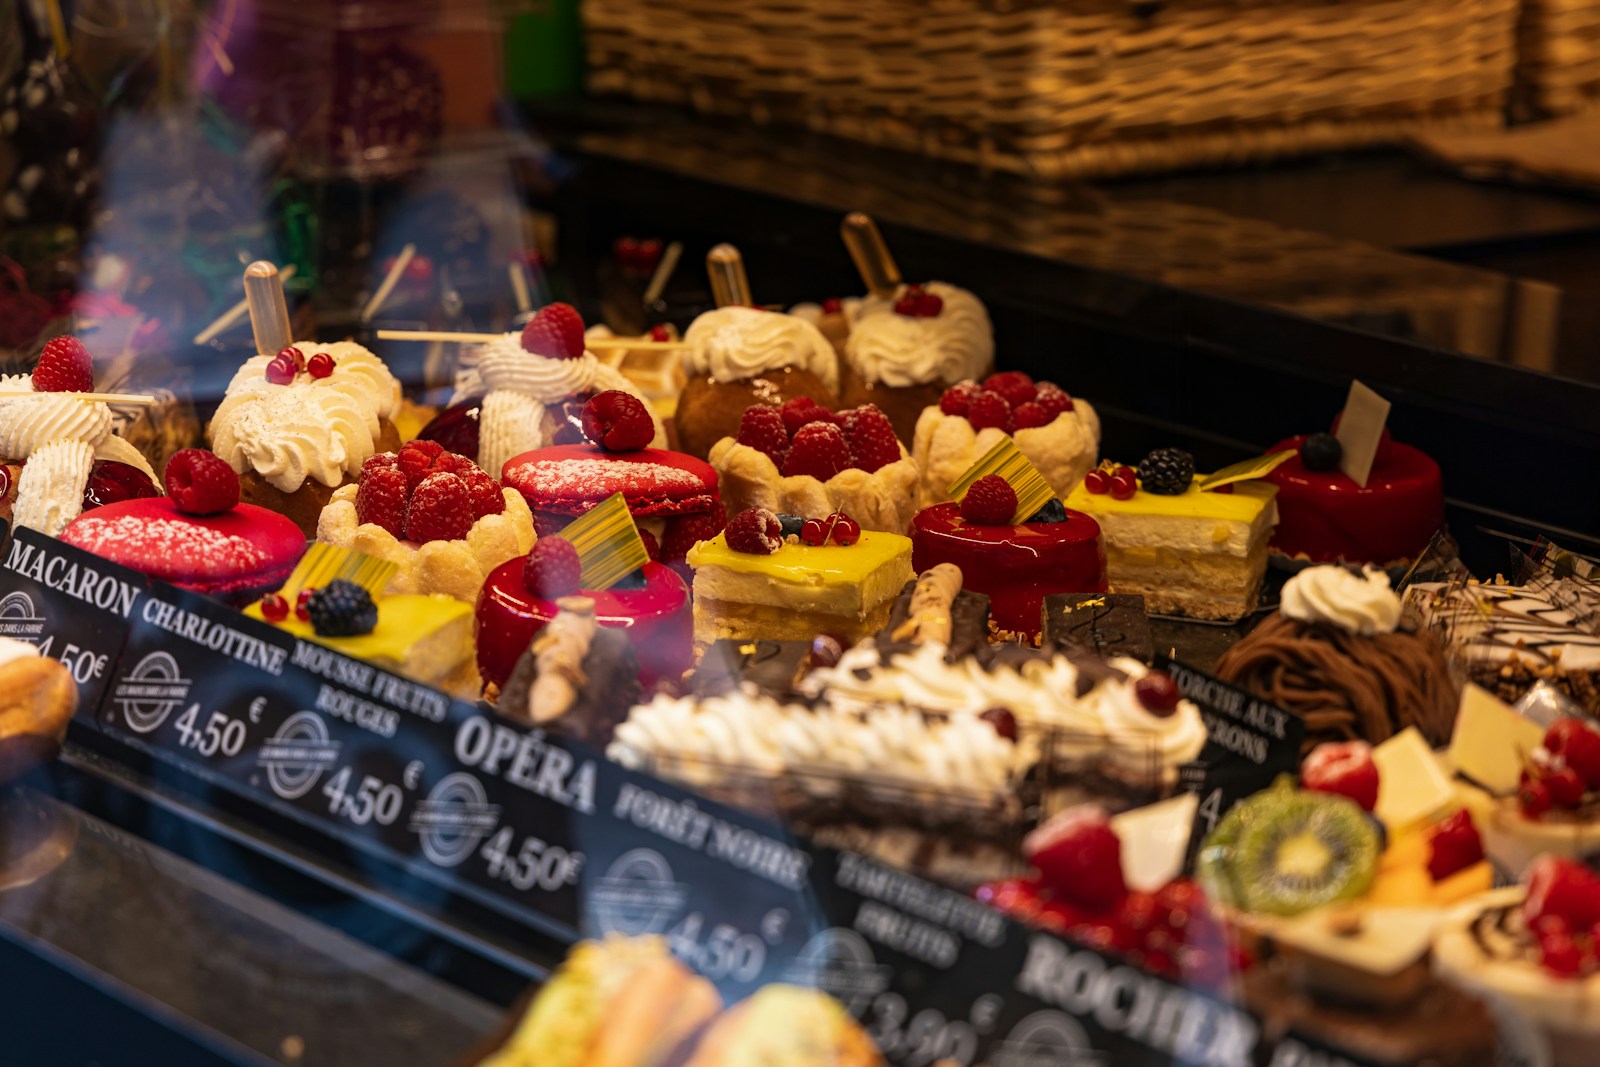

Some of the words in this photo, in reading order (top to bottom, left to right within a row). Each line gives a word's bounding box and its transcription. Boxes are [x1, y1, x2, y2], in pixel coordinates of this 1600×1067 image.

[4, 539, 140, 618] MACARON
[142, 598, 288, 676] CHARLOTTINE
[291, 640, 376, 693] MOUSSE
[372, 672, 449, 723] FRUITS
[315, 684, 400, 738] ROUGES
[1168, 663, 1245, 719] TORCHE
[1242, 700, 1289, 739] AUX
[174, 702, 247, 757] 4,50
[455, 715, 597, 815] OPÉRA
[322, 766, 403, 825] 4,50
[613, 782, 714, 849] FORÊT
[707, 819, 812, 890] NOIRE
[1015, 933, 1259, 1067] ROCHER
